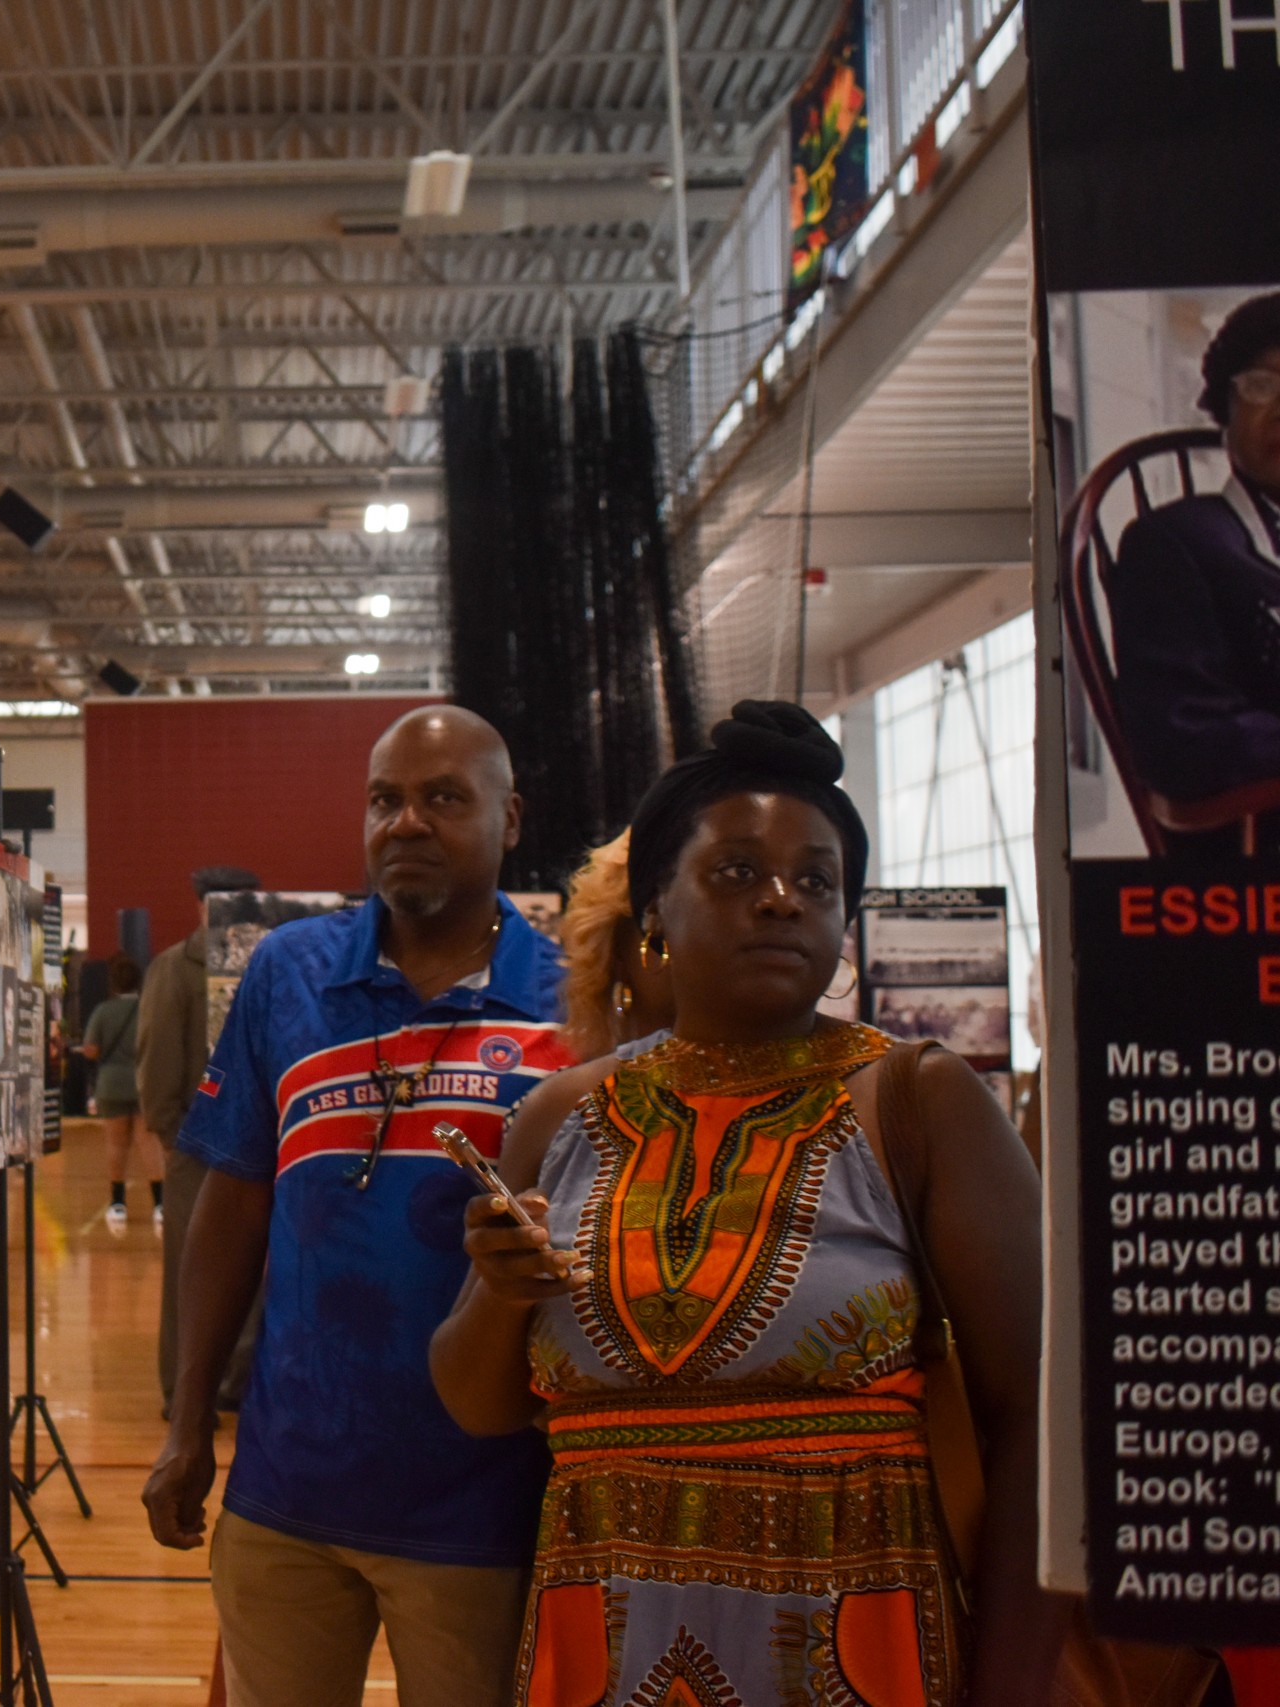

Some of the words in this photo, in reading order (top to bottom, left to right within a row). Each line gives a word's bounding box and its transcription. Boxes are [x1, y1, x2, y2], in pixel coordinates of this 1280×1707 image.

[1107, 1043, 1191, 1077] Mrs.
[308, 1089, 349, 1115] LES
[353, 1072, 500, 1105] GRADIERS
[1107, 1090, 1257, 1131] singing
[1108, 1137, 1173, 1178] girl
[1186, 1137, 1259, 1171] and
[1110, 1184, 1280, 1225] grandfat
[1112, 1232, 1244, 1274] played
[1112, 1280, 1252, 1314] started
[1113, 1333, 1280, 1368] accomp
[1116, 1421, 1271, 1464] Europe,
[1117, 1469, 1229, 1505] book:
[1117, 1518, 1191, 1552] and
[1116, 1562, 1280, 1600] America
